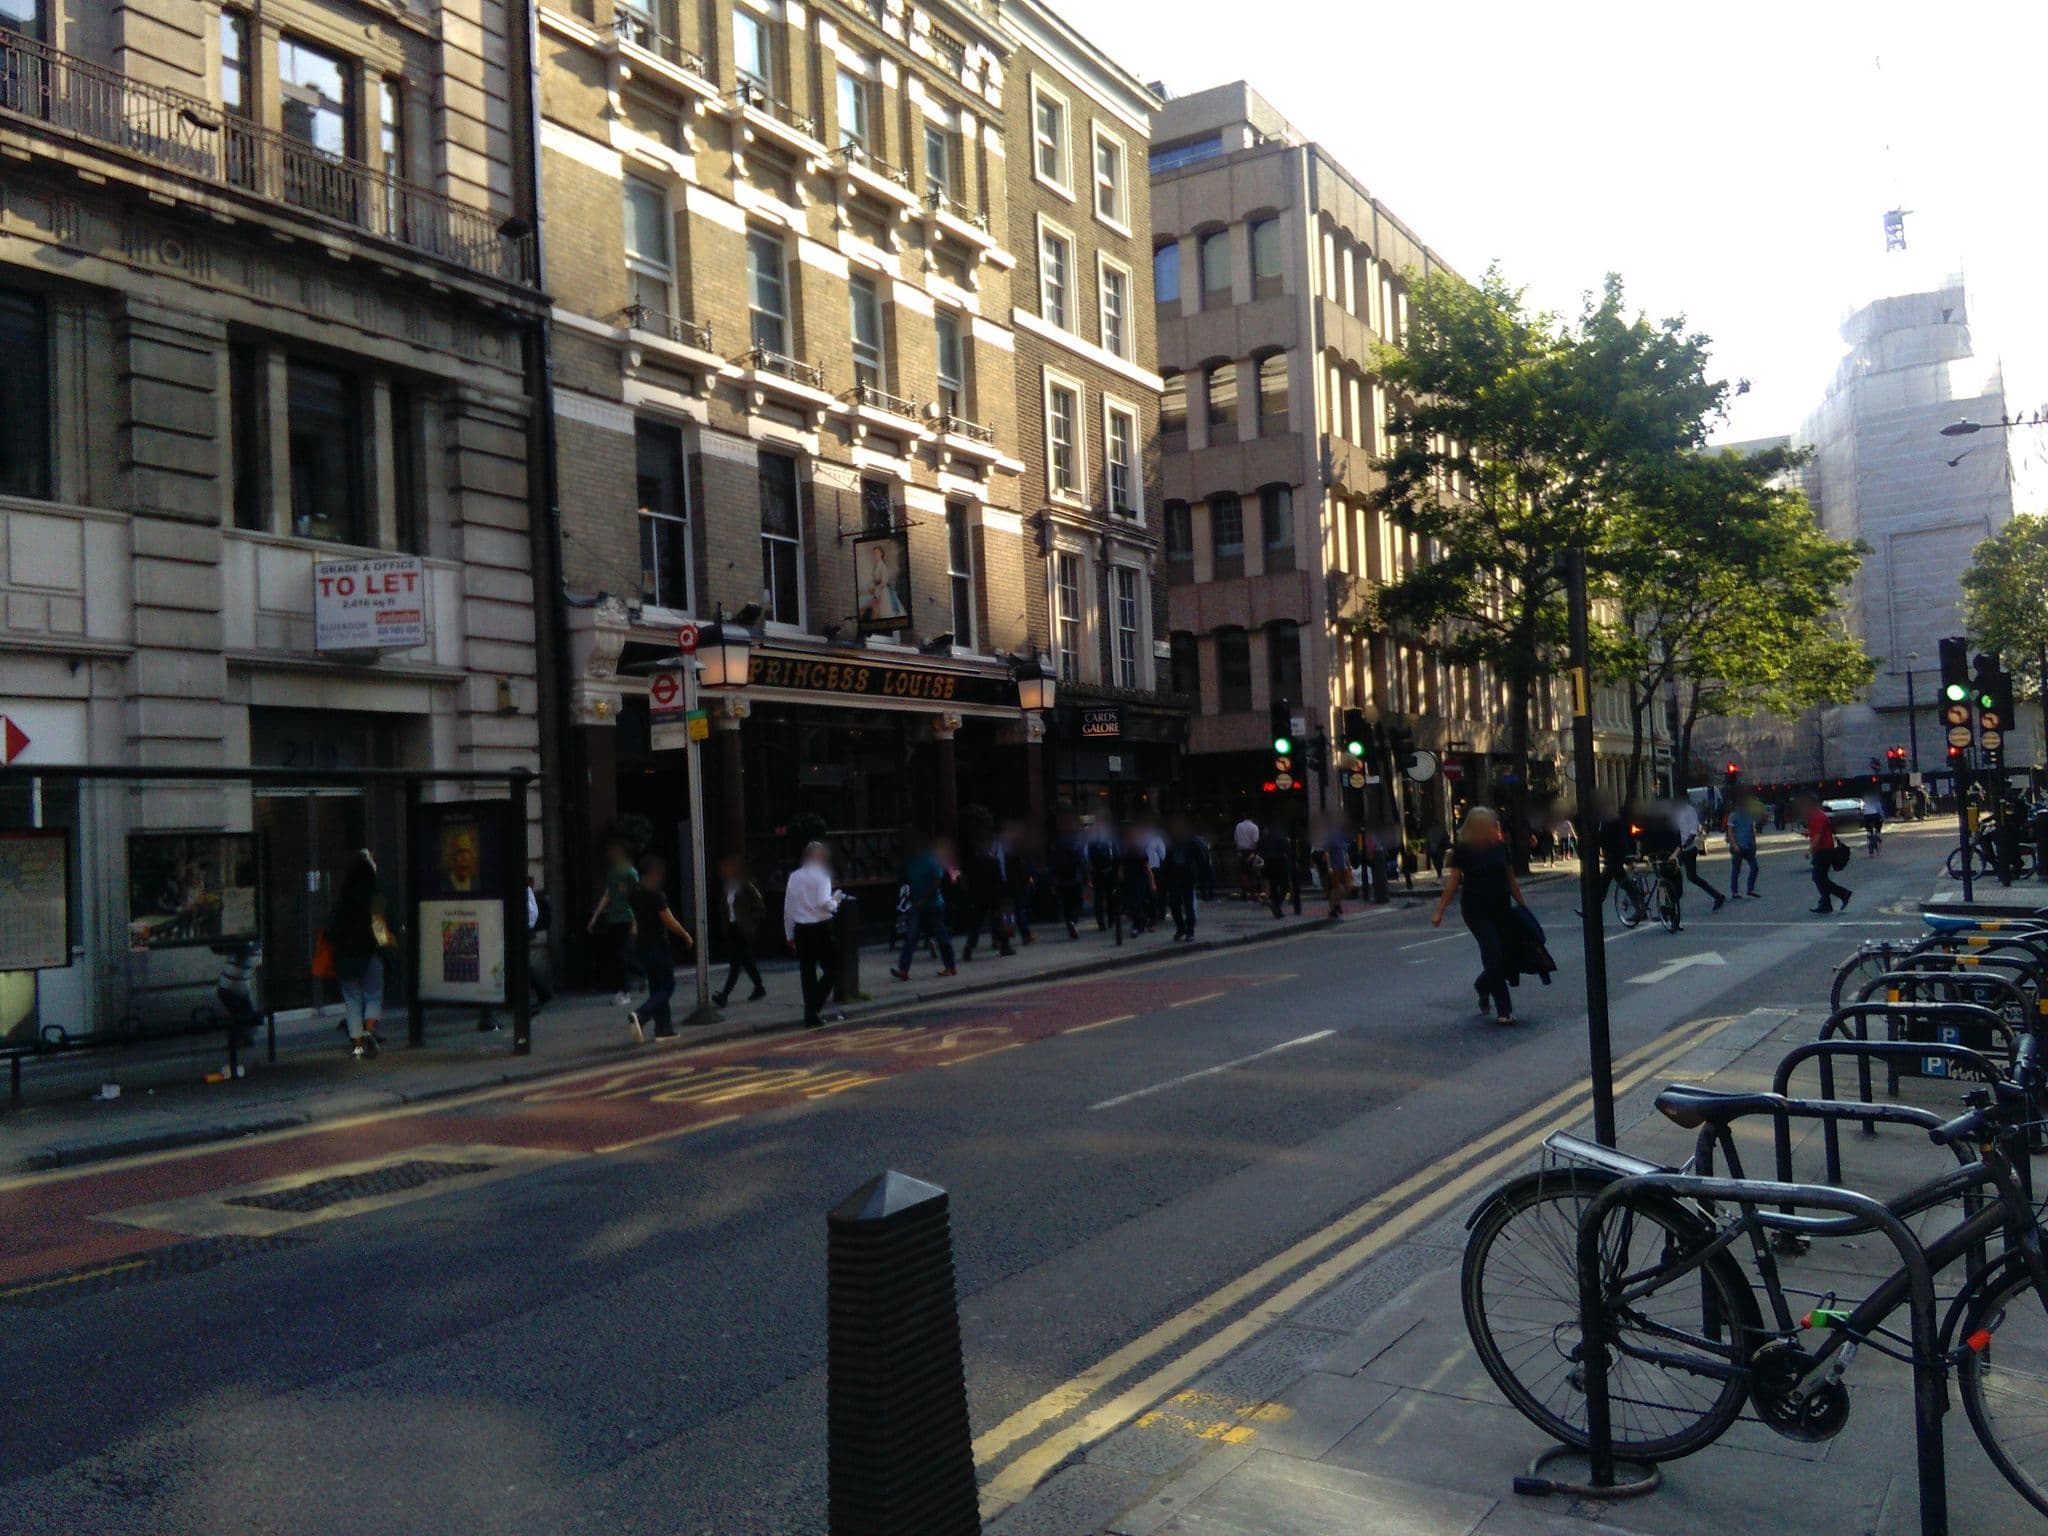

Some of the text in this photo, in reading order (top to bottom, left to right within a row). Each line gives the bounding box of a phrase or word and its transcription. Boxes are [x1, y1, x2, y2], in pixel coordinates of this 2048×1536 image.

[321, 564, 359, 574] GRADE
[374, 561, 415, 571] OFFICE
[318, 572, 418, 597] TO LET
[750, 659, 956, 698] PRINCESS LOUISE
[1084, 711, 1118, 722] CARDS
[1082, 722, 1120, 734] GALORE
[1927, 1056, 1942, 1072] P
